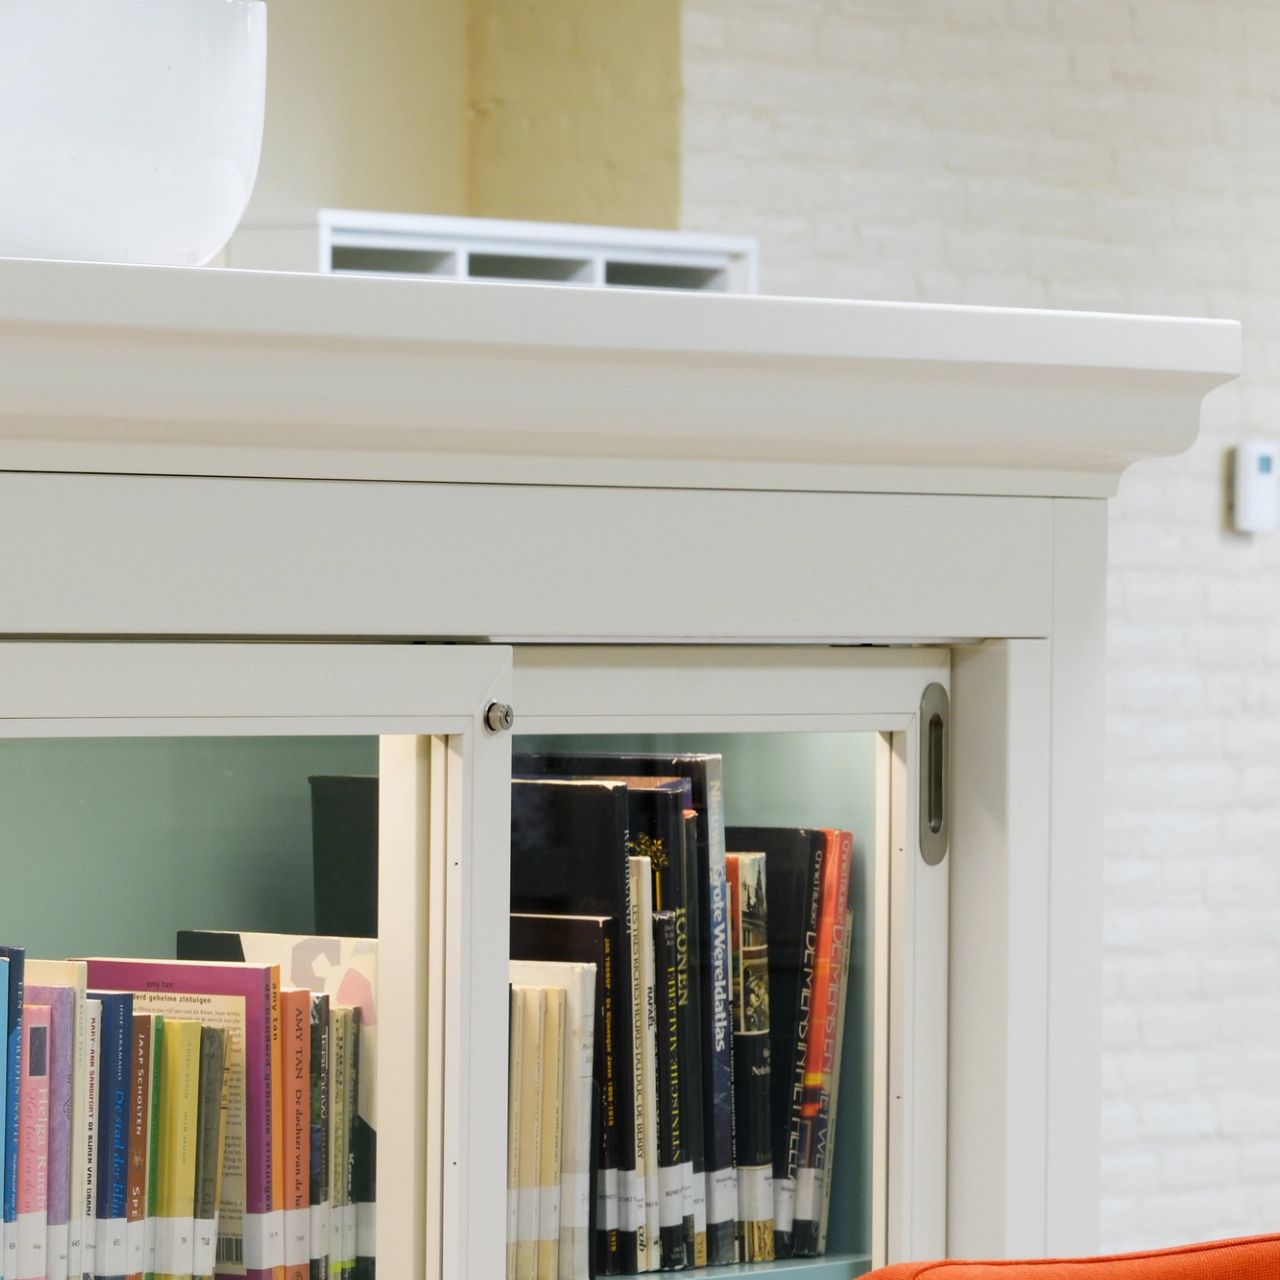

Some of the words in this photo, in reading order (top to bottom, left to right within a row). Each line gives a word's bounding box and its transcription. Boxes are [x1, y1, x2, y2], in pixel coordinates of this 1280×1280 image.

[675, 907, 687, 1006] ICONEN
[179, 996, 212, 1004] zintuigen
[712, 924, 727, 1052] Wereldatlas
[295, 1008, 303, 1042] AMY
[137, 1032, 145, 1064] JAAP
[295, 1047, 303, 1080] TAN
[136, 1069, 145, 1136] SCHOLTEN
[295, 1089, 303, 1105] De
[295, 1107, 303, 1150] dochter
[295, 1178, 303, 1192] de
